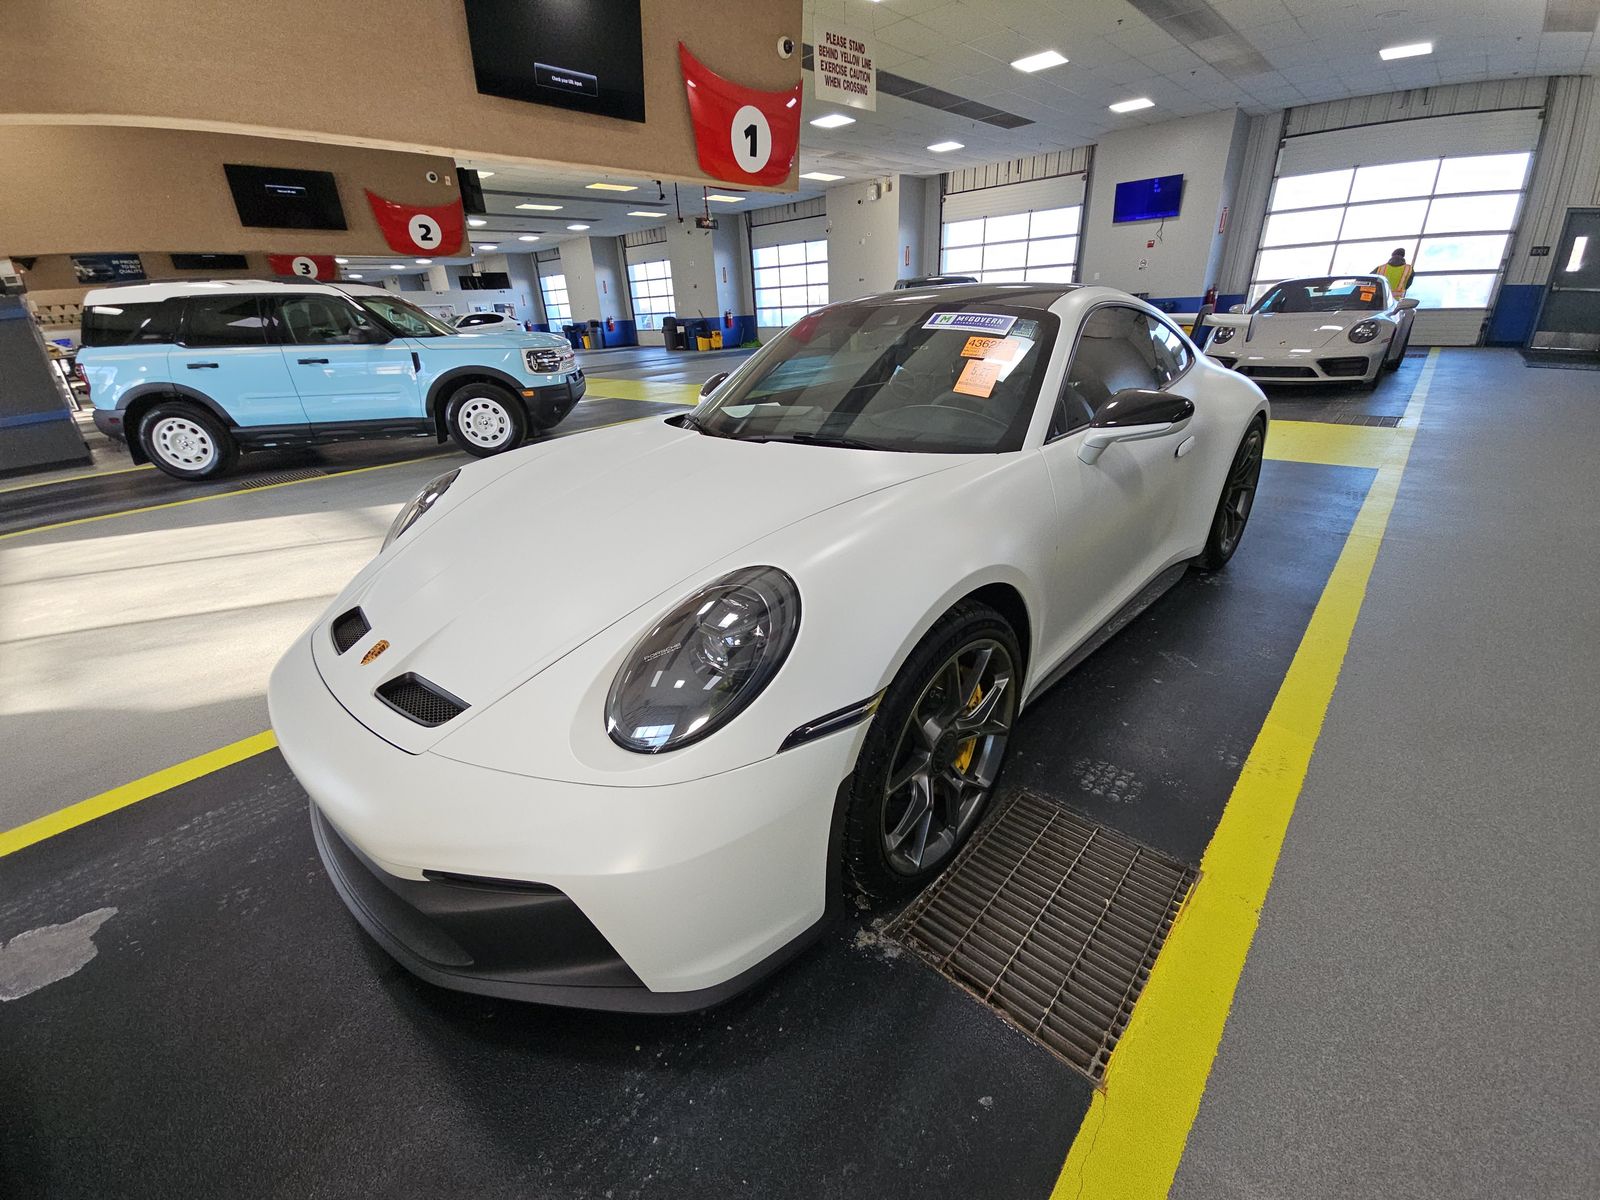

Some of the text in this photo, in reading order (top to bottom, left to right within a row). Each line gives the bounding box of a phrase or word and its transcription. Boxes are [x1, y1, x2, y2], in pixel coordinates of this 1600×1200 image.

[825, 31, 865, 54] PLEASE STAND
[818, 45, 872, 70] BEHIND YELLOW LINE
[820, 60, 871, 83] EXERCISE CAUTION
[824, 75, 868, 95] WHEN CROSSING
[743, 123, 758, 158] 1
[418, 223, 434, 242] 2
[299, 262, 312, 275] 3
